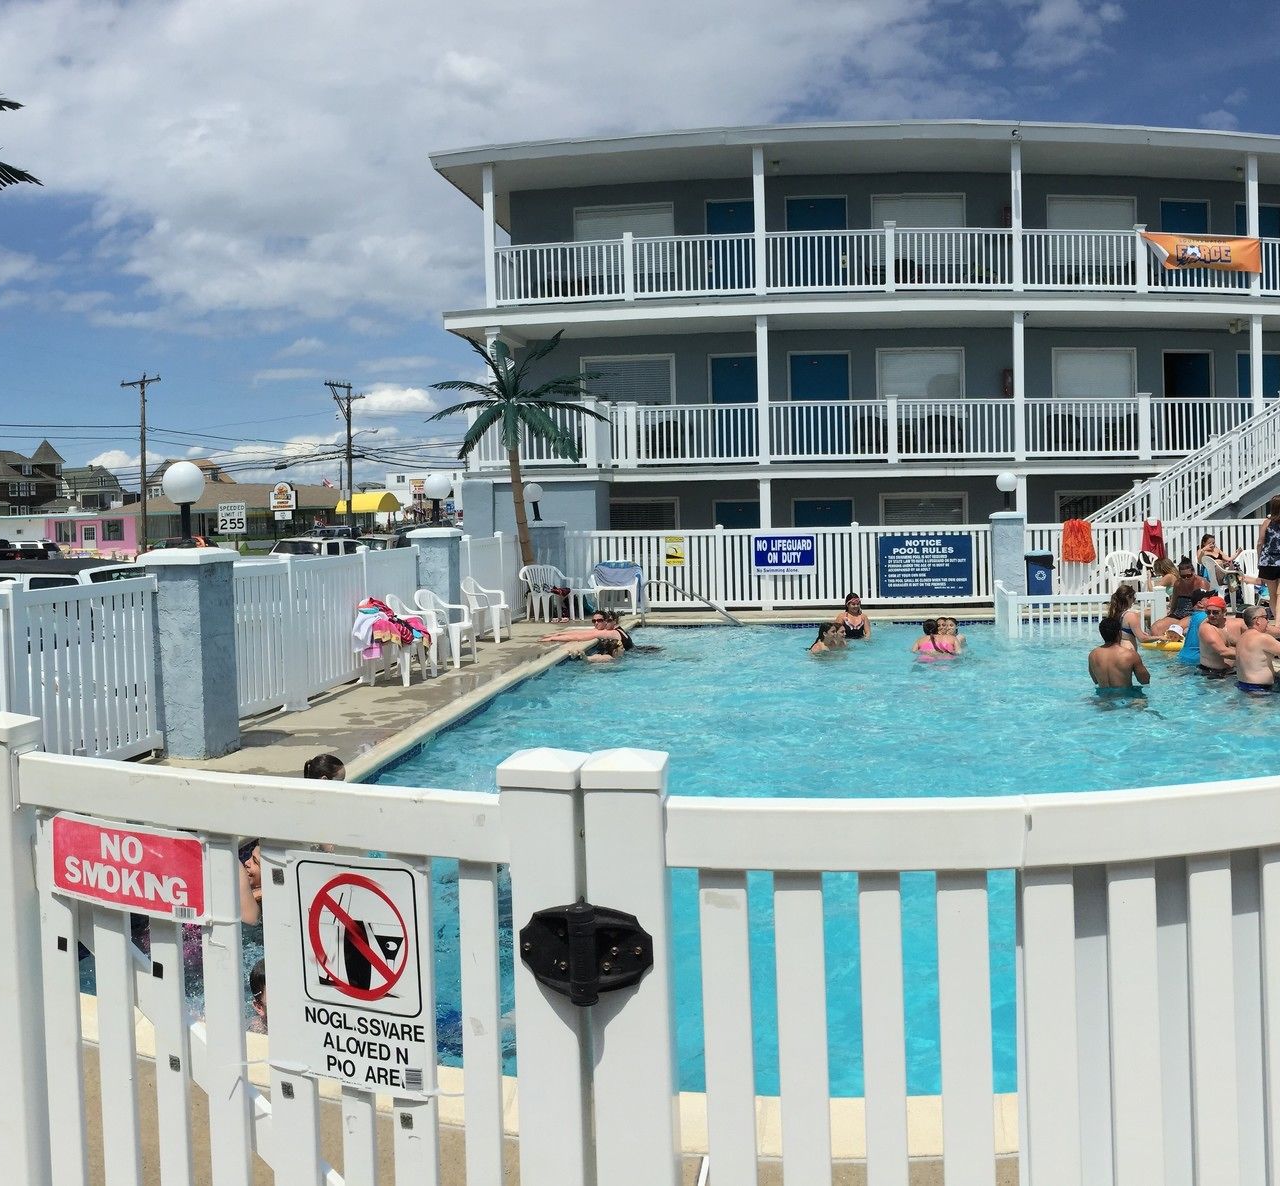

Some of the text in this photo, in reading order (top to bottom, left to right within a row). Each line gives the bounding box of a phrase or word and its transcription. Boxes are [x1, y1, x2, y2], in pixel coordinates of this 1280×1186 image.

[220, 518, 245, 530] 255
[756, 539, 812, 552] NO LIFEGUARD
[922, 546, 954, 554] RULES
[768, 552, 802, 564] ON DUTY
[100, 832, 144, 865] NO
[364, 1066, 406, 1089] ARE
